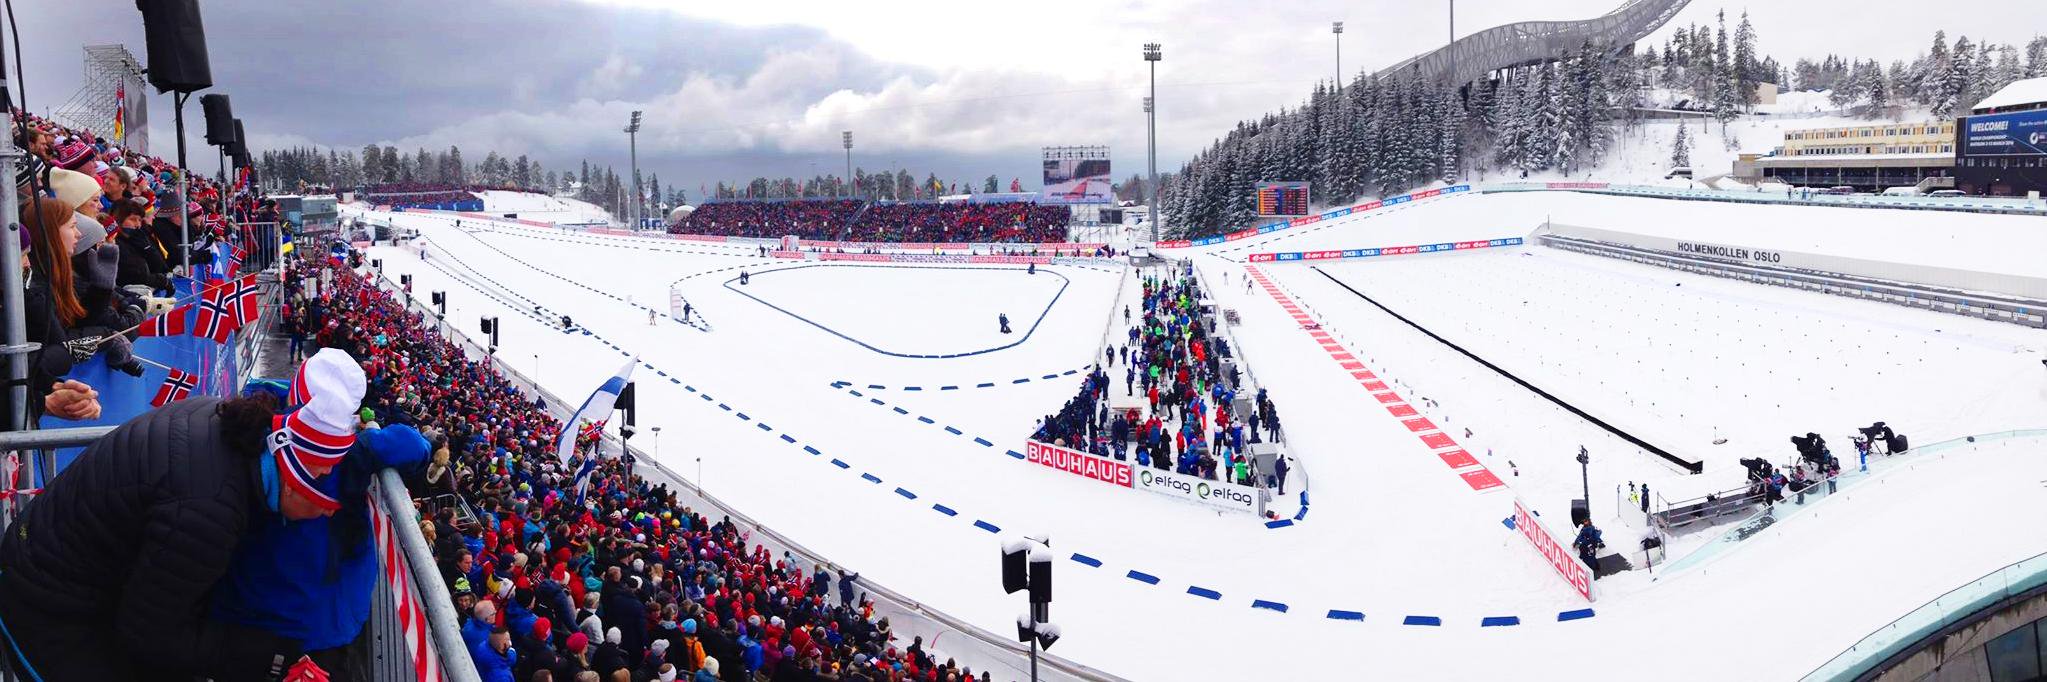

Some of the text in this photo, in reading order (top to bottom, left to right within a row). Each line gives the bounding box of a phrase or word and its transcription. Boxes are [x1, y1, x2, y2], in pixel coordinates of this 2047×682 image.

[1971, 121, 2009, 132] WELCOME!
[1677, 242, 1781, 263] HOLMENKOLLEN OSLO
[1028, 445, 1130, 484] BAUHAUS
[1155, 476, 1191, 494] elfag
[1213, 488, 1252, 506] elfag
[1516, 505, 1588, 596] BAUHAUS
